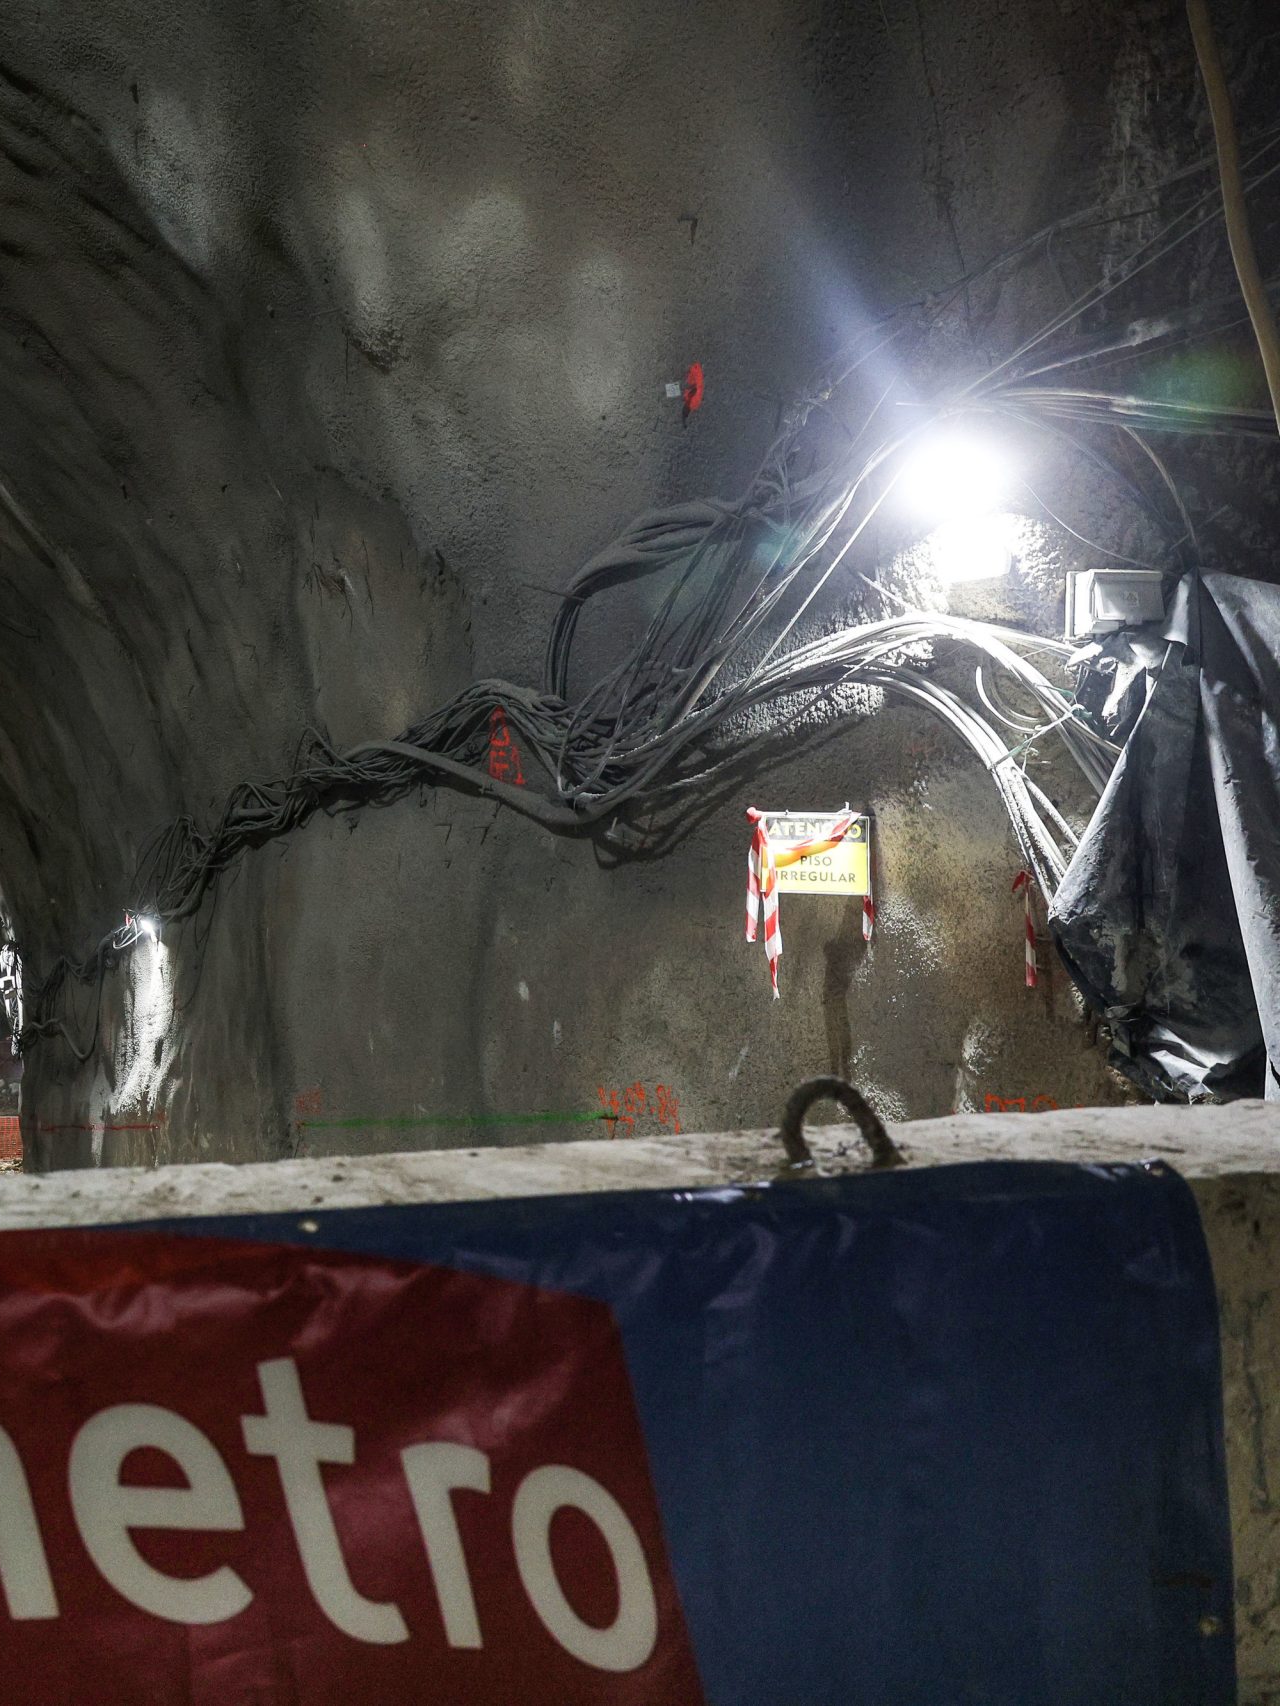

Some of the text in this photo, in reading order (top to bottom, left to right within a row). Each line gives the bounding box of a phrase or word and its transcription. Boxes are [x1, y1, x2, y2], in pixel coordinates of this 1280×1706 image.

[769, 819, 862, 839] ATENO
[800, 855, 832, 866] PISO
[775, 870, 856, 882] IRREGULAR
